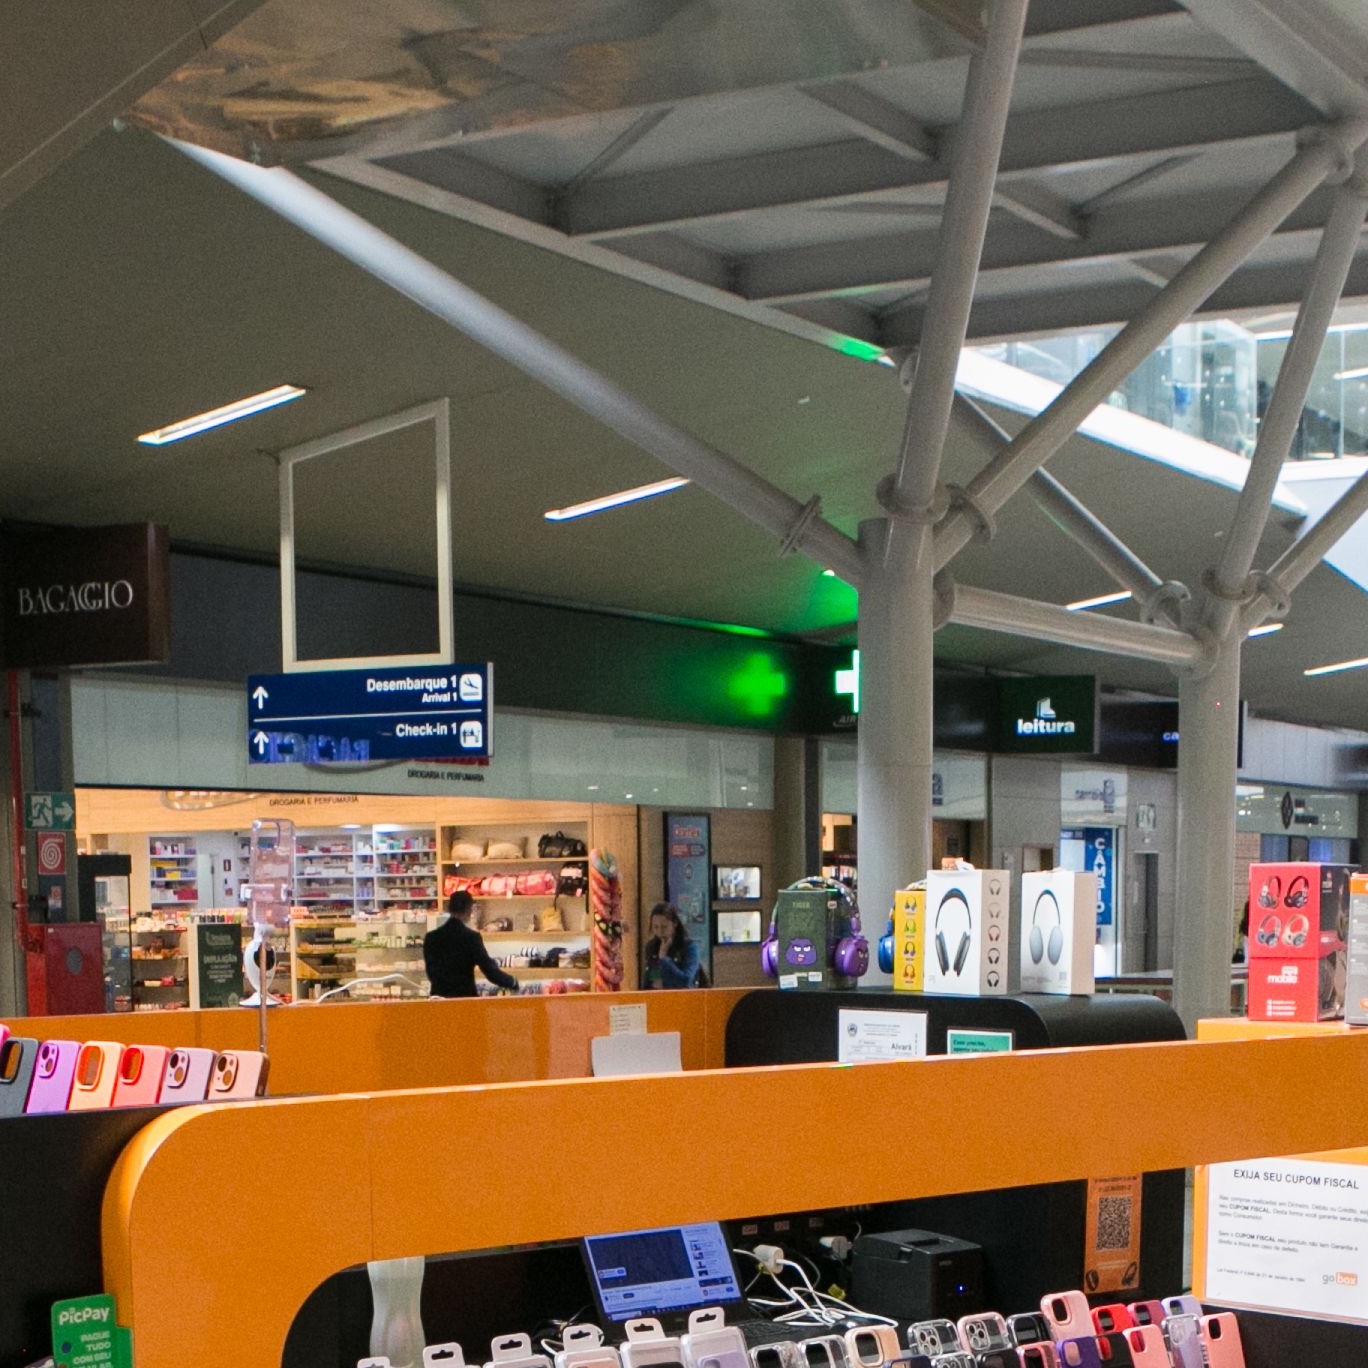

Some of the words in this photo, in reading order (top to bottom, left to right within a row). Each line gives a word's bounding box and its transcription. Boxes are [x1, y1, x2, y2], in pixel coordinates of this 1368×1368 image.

[18, 580, 133, 615] BAGAGGIO
[366, 677, 448, 692] Desembarque
[450, 675, 457, 688] 1
[421, 692, 450, 703] Arrival
[395, 723, 448, 737] Check-in
[450, 722, 457, 735] 1
[1016, 718, 1076, 735] leitura
[408, 769, 439, 780] DROGARIA
[447, 771, 485, 782] PERFUMARIA
[1233, 1168, 1261, 1180] EXIJA
[1263, 1172, 1283, 1182] SEU
[1285, 1174, 1321, 1186] CUPOM
[1323, 1178, 1360, 1190] FISCAL
[1322, 1273, 1335, 1285] go
[1337, 1273, 1357, 1285] box
[58, 1306, 111, 1326] PicPay
[86, 1341, 112, 1351] TUDO
